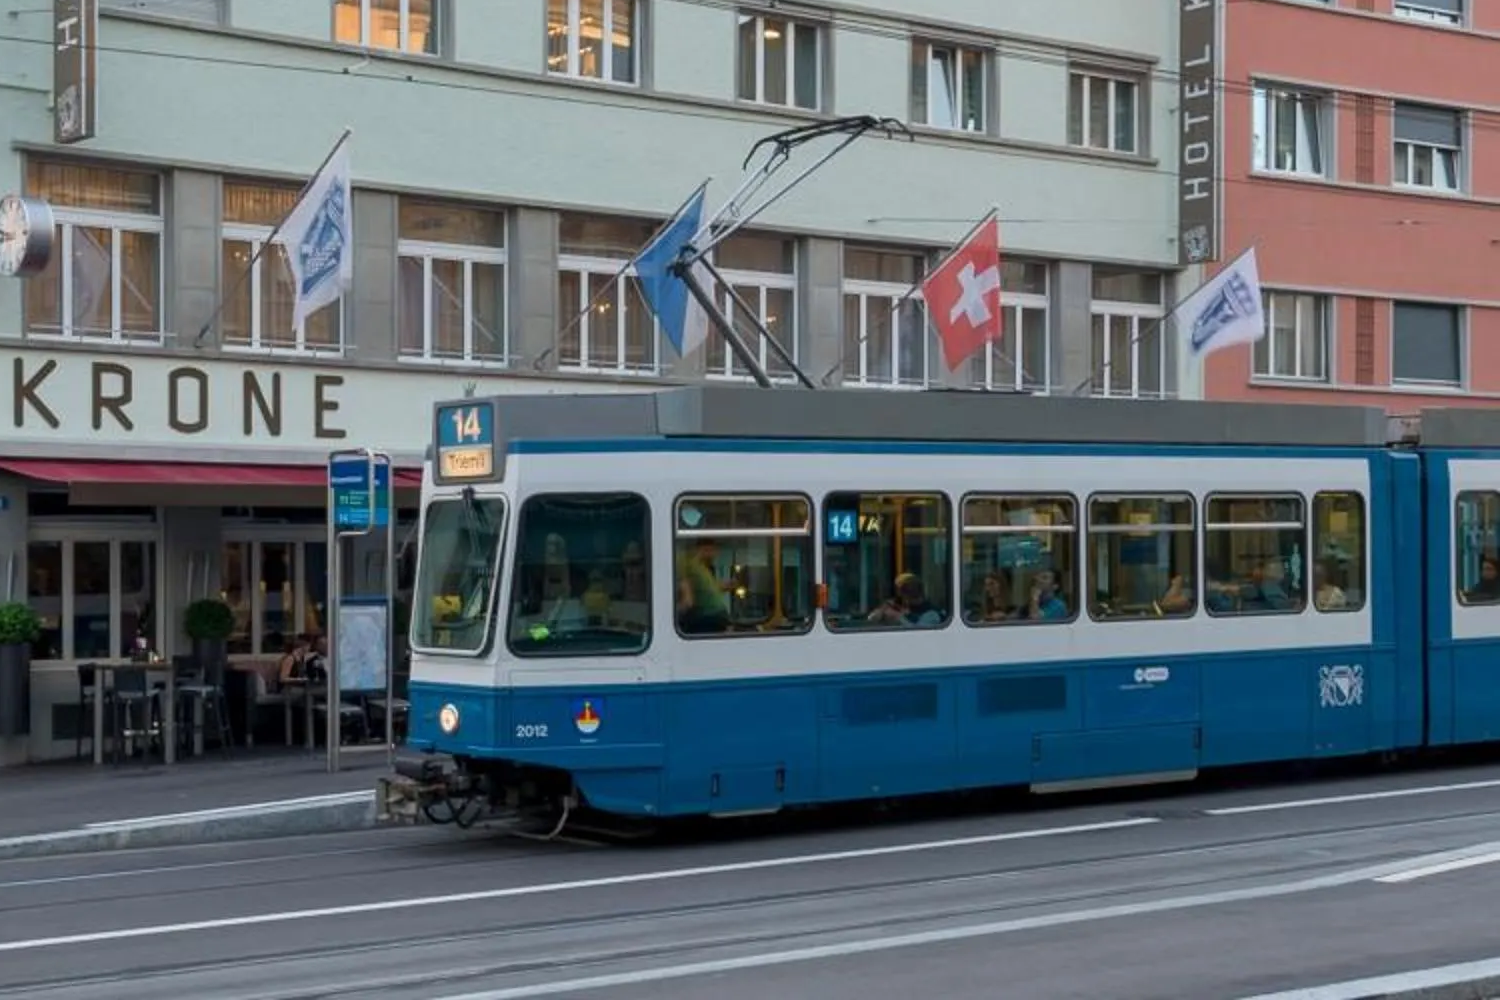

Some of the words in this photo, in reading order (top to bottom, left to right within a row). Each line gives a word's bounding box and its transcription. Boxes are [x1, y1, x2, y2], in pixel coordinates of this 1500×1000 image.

[1183, 44, 1211, 201] HOTEL
[13, 357, 347, 439] KRONE
[452, 407, 482, 443] 14
[830, 515, 853, 537] 14
[516, 725, 549, 737] 2012
